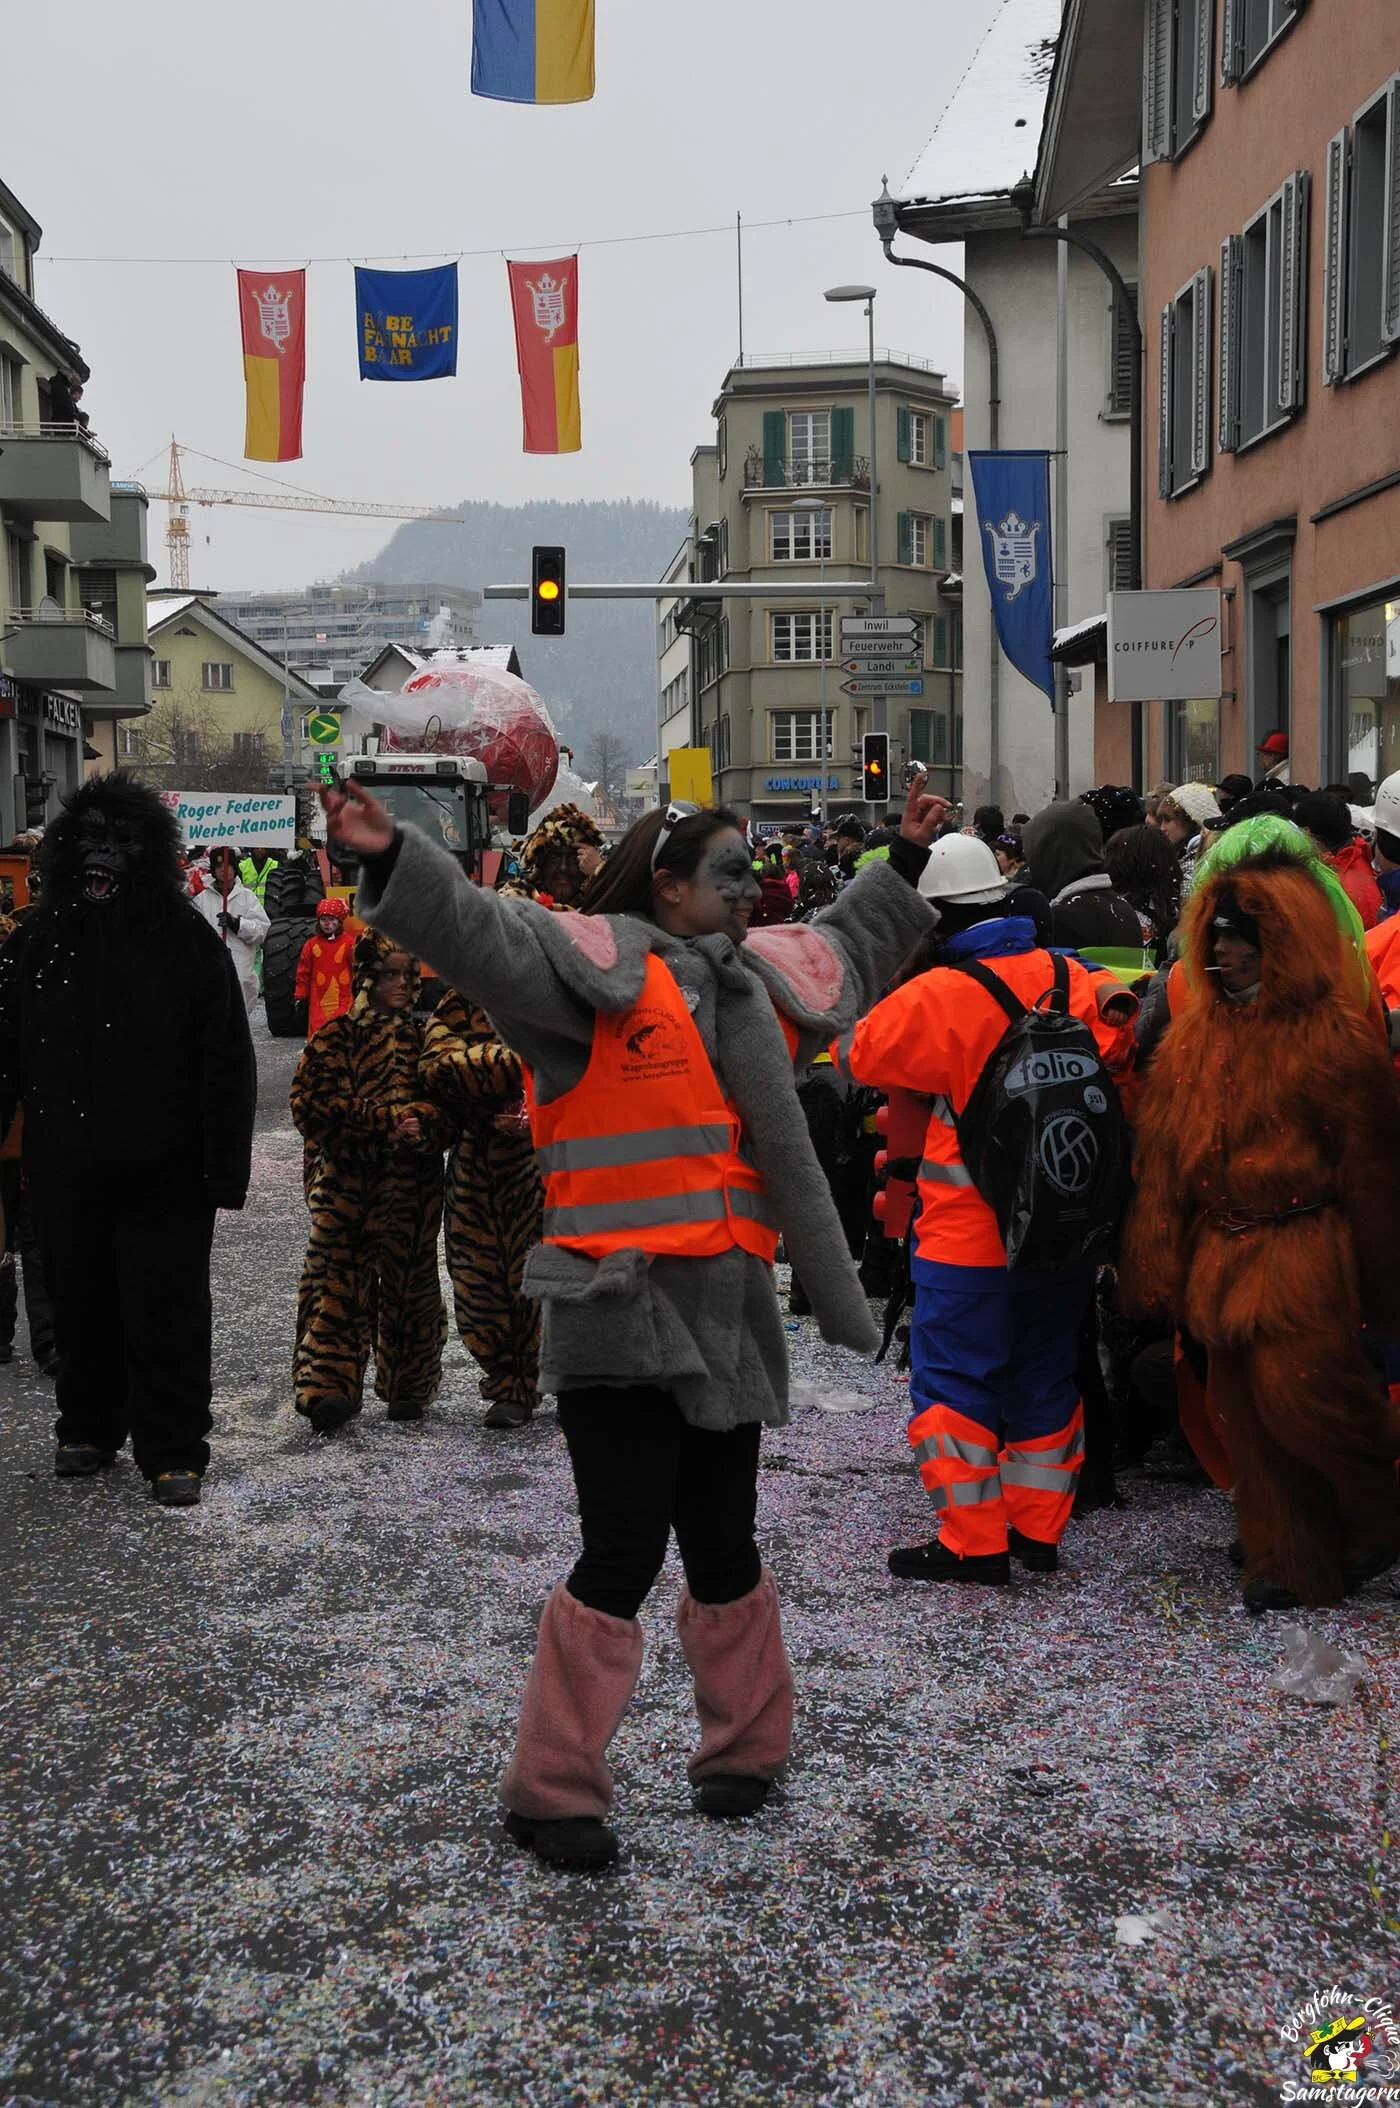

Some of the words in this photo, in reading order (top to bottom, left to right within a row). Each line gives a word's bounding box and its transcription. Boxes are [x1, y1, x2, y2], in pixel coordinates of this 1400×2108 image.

[864, 620, 889, 631] Inwil
[849, 641, 903, 651] Feuerwehr
[1114, 640, 1175, 652] COIFFURE
[867, 661, 895, 672] Landi
[47, 695, 81, 729] FALKEN
[387, 764, 426, 773] STEYR
[177, 803, 221, 821] Roger
[226, 798, 283, 814] Federer
[188, 816, 295, 839] Werbe-Kanone
[1019, 1053, 1084, 1083] folio
